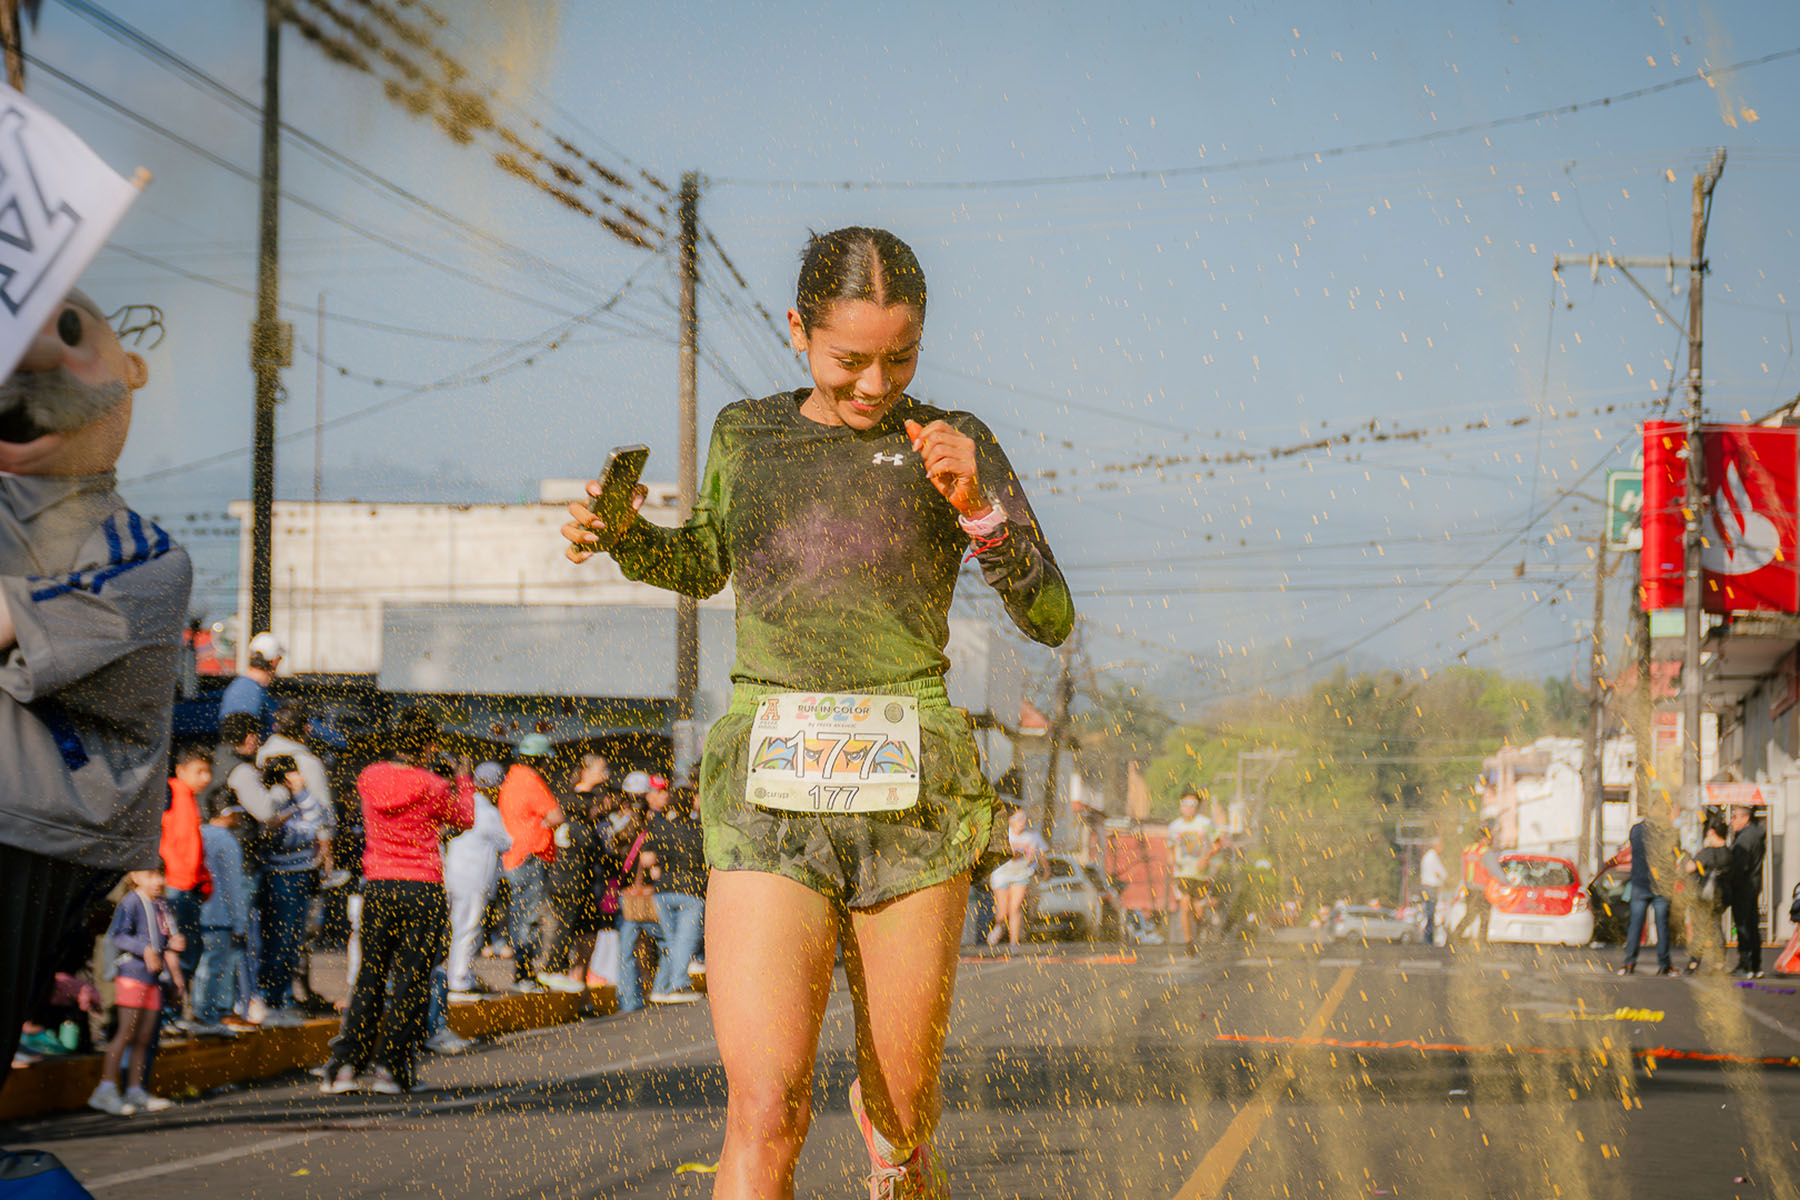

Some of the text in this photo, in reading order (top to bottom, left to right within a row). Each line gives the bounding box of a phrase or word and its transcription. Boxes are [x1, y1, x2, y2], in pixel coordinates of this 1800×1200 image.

[761, 698, 780, 721] A
[797, 704, 870, 715] RUN IN COLOR
[786, 730, 888, 780] 177
[808, 784, 859, 810] 177
